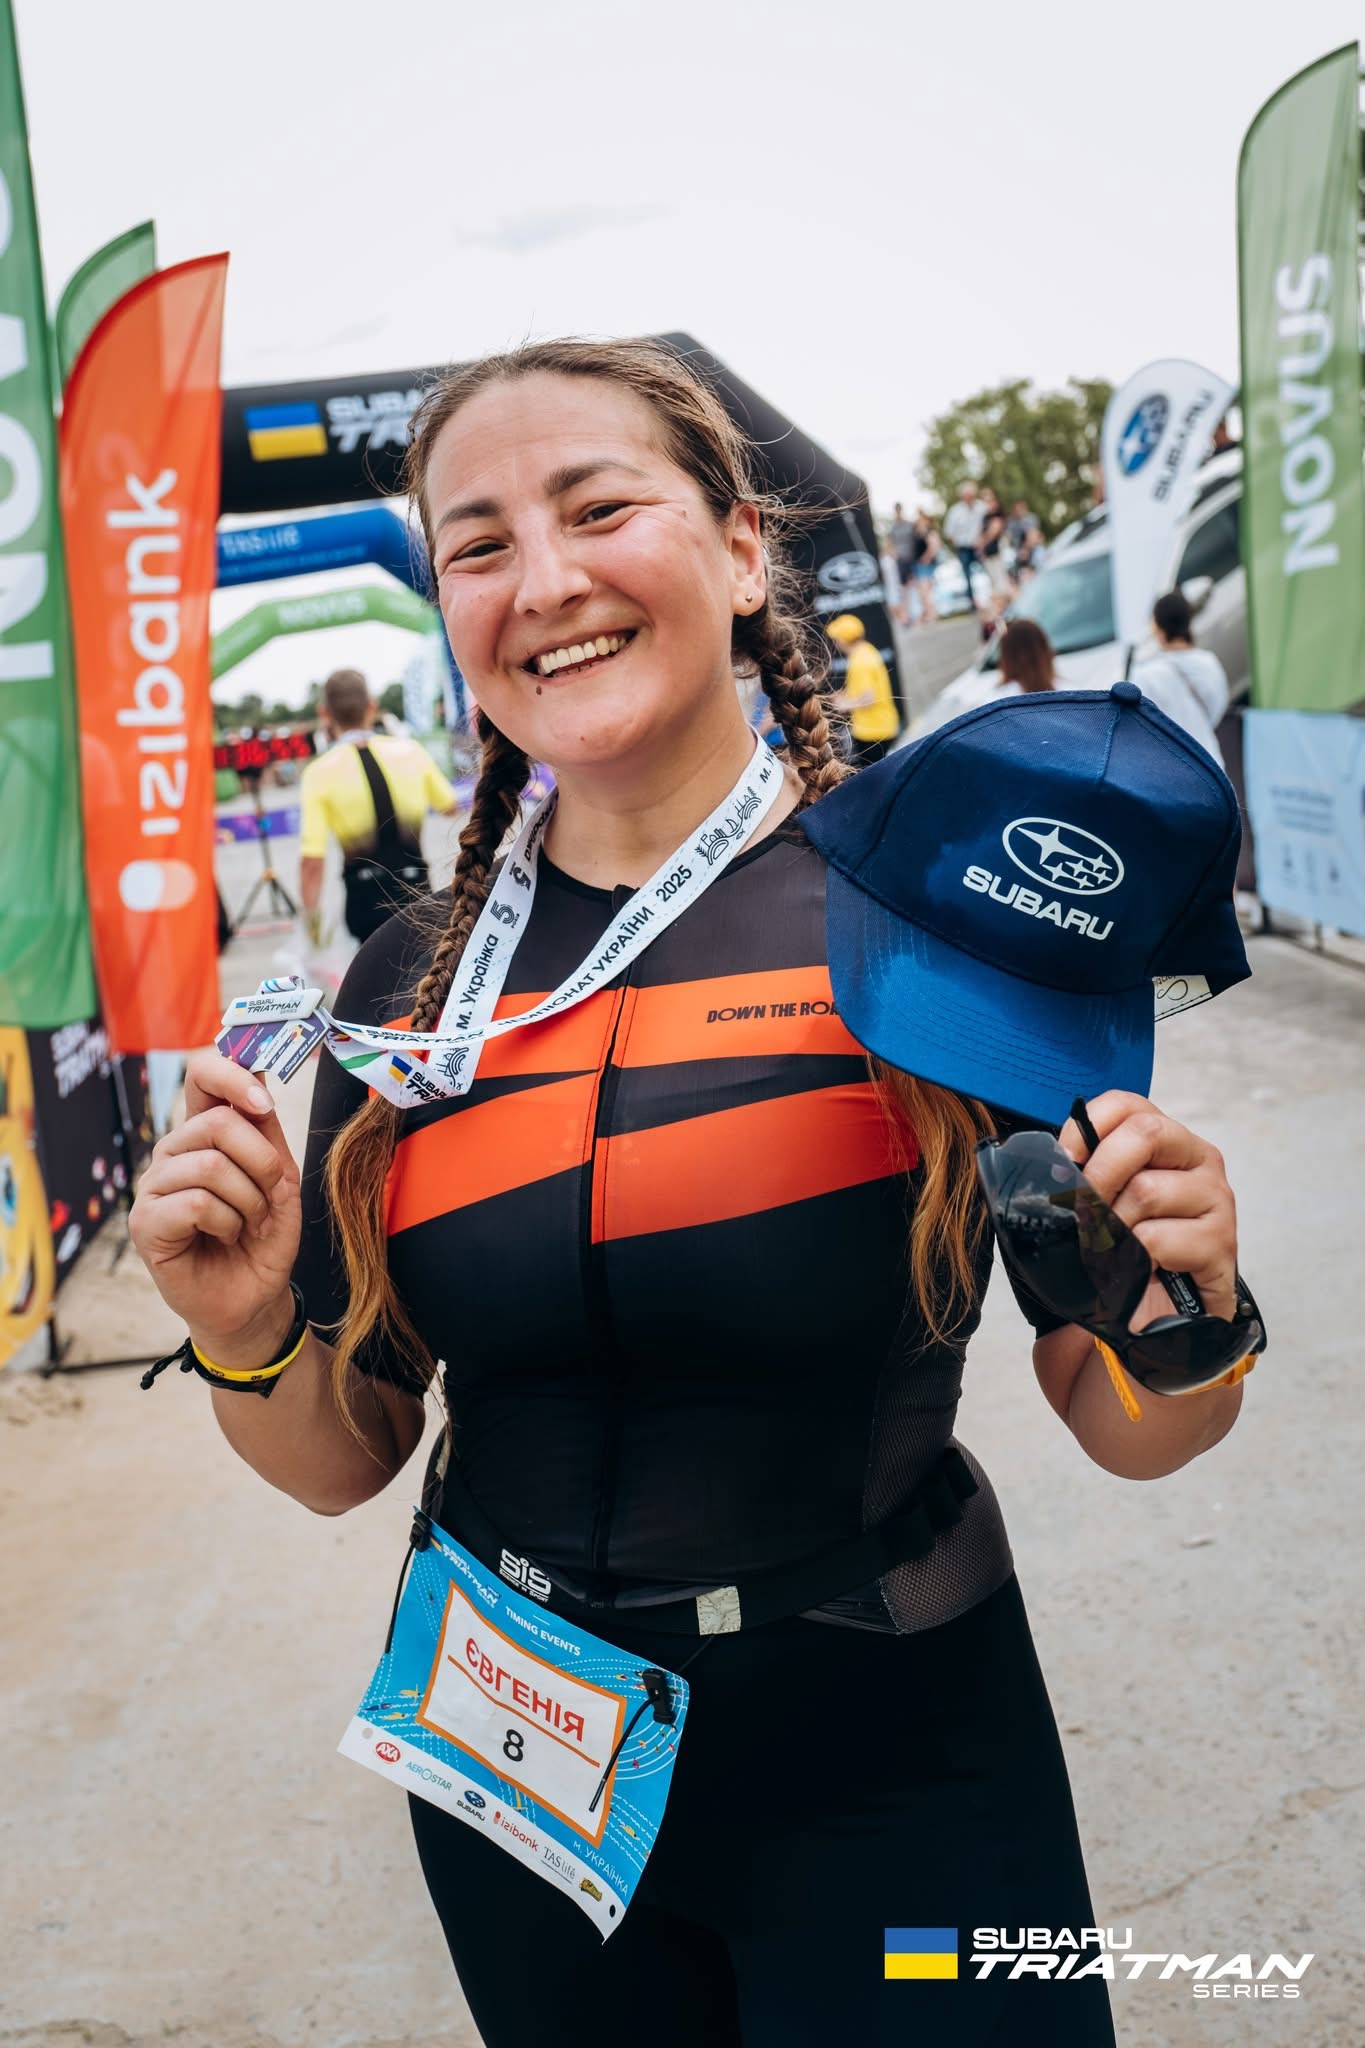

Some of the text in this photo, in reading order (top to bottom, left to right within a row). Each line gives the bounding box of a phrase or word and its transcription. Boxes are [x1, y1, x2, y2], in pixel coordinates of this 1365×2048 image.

[1276, 252, 1339, 575] NOVUS
[107, 467, 188, 837] izibank
[962, 865, 1114, 941] SUBARU
[460, 933, 499, 1006] Українка
[497, 864, 693, 1026] ЧЕМПІОНАТ УКРАЇНИ 2025
[247, 1001, 301, 1014] TRIATMAN
[706, 1004, 767, 1023] DOWN
[770, 1003, 797, 1018] THE
[505, 1606, 582, 1657] TIMING EVENTS
[466, 1637, 585, 1742] ЄВГЕНІЯ
[376, 1743, 399, 1761] AXA
[502, 1728, 525, 1763] 8
[405, 1761, 453, 1792] AEROSTAR
[456, 1799, 486, 1822] SUBARU
[543, 1846, 562, 1868] TAS
[585, 1846, 629, 1897] УКРАЇНКА
